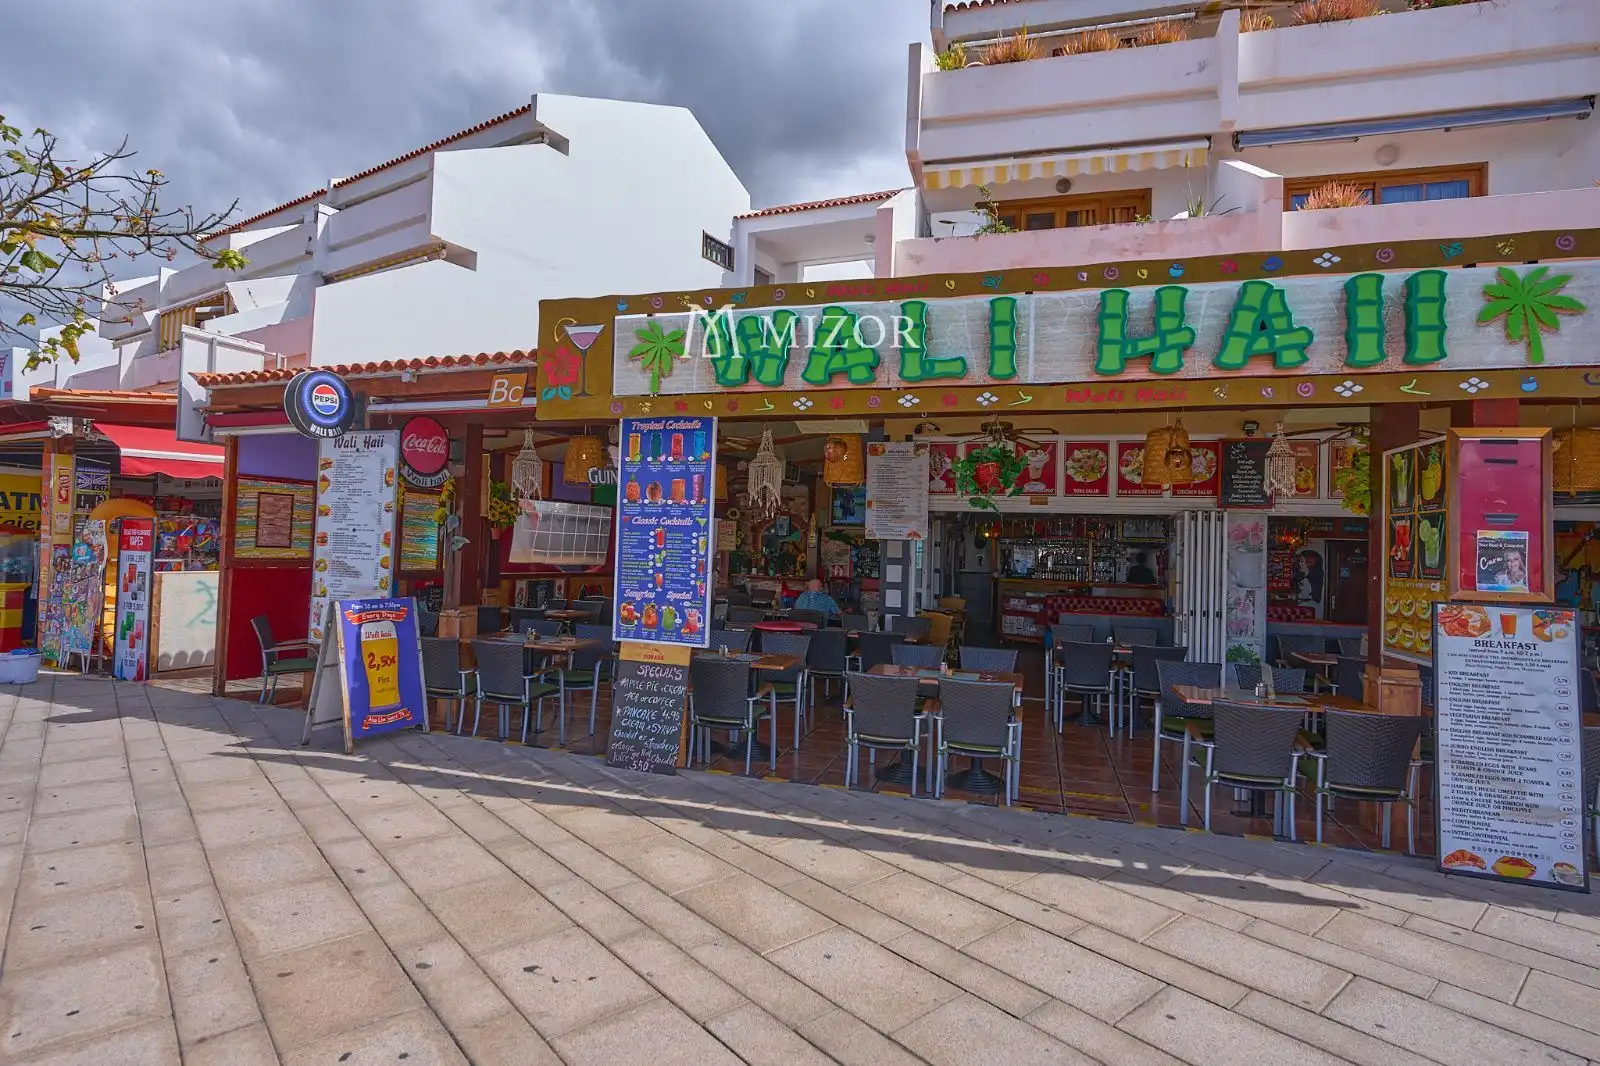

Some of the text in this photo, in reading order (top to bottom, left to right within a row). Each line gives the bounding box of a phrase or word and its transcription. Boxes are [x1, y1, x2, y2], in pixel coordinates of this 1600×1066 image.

[700, 269, 1449, 387] WALI HAII
[490, 379, 522, 403] Bc
[314, 395, 338, 404] PEPSI
[310, 423, 327, 436] WALI
[632, 420, 664, 432] Tropical
[333, 434, 385, 449] Wali Haii
[407, 469, 427, 486] Wali
[1474, 639, 1538, 651] BREAKFAST
[377, 676, 390, 684] Pint
[623, 677, 644, 691] APPLE
[646, 681, 659, 692] PIE
[624, 692, 640, 703] TEA
[648, 696, 676, 707] COFFEE
[623, 705, 658, 721] PANCAKE
[1451, 759, 1484, 767] SCRAMBLED
[1451, 771, 1484, 779] SCRAMBLED
[1451, 806, 1500, 817] MEDITERRANEAN
[1502, 805, 1531, 813] PINEAPPLE
[1451, 818, 1491, 827] CONTINENTAL
[1452, 829, 1508, 841] INTERCONTINENTAL
